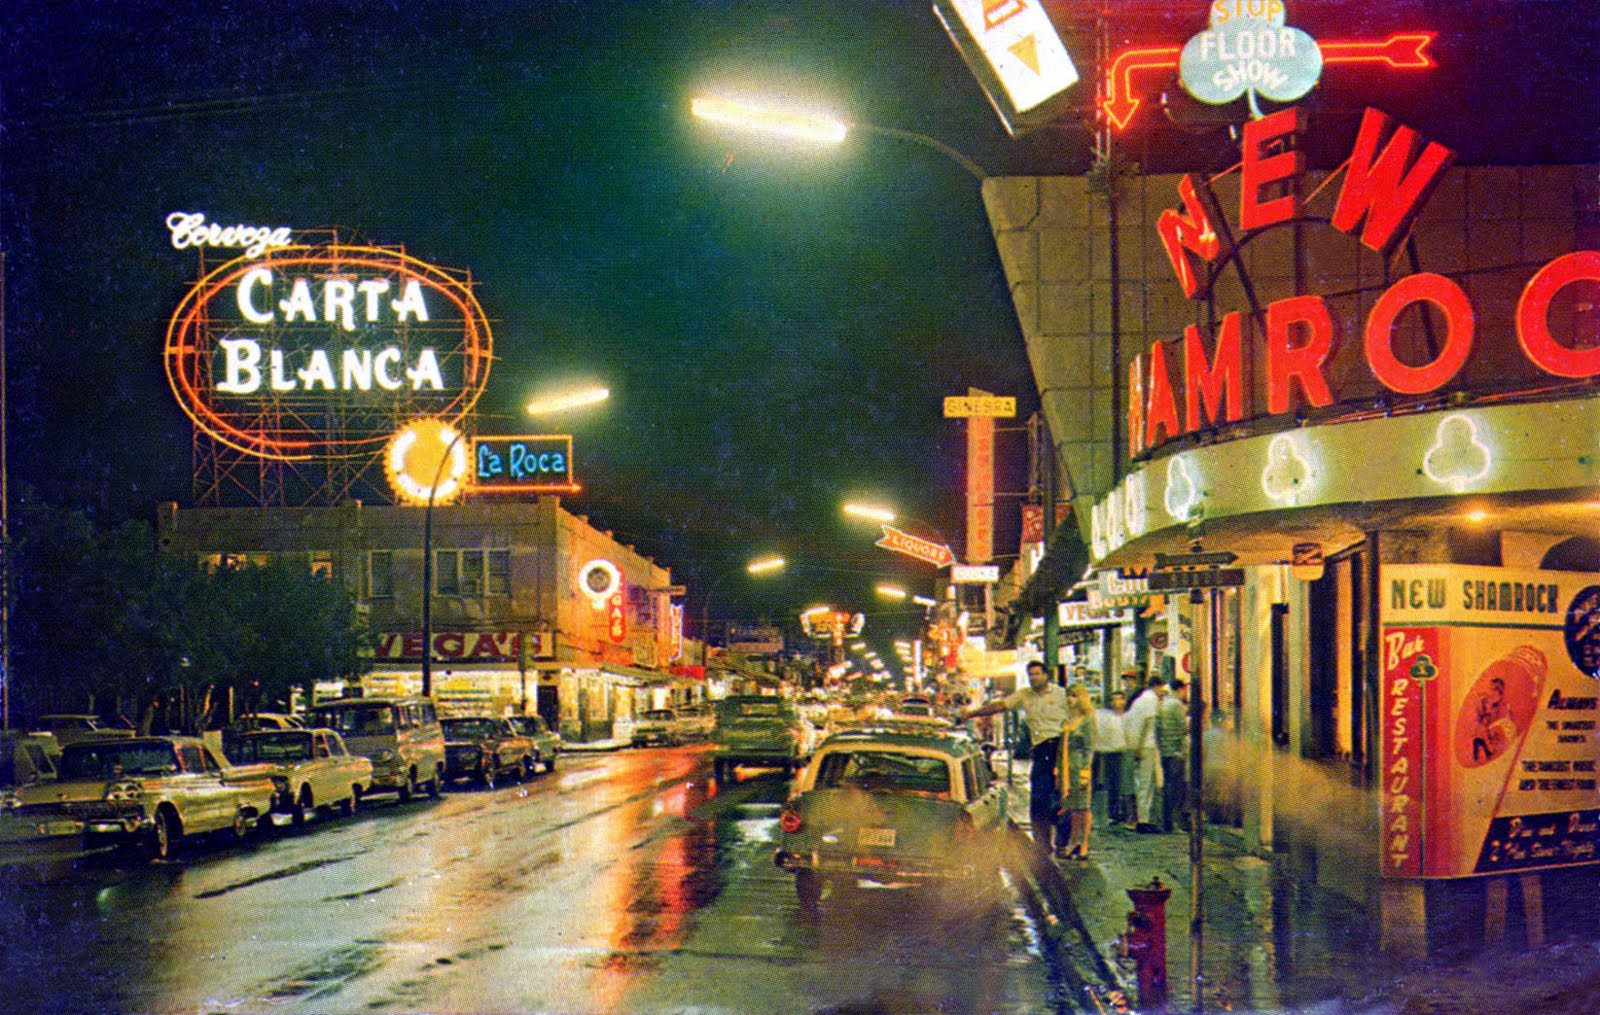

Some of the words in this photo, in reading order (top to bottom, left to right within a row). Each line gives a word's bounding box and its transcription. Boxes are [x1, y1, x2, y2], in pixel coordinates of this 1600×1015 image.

[1201, 27, 1296, 61] FLOOR
[1213, 59, 1289, 92] SHOW
[1157, 107, 1454, 299] NEW
[166, 212, 292, 258] Cerveza
[236, 268, 429, 331] CARTA
[217, 338, 444, 394] BLANCA
[477, 444, 502, 477] La
[510, 443, 566, 477] Roca
[891, 535, 946, 562] LIQUORS
[1391, 579, 1446, 609] NEW
[1463, 580, 1558, 613] SHAMROCK
[1386, 632, 1425, 671] Bar
[1390, 678, 1410, 869] RESTAURANT
